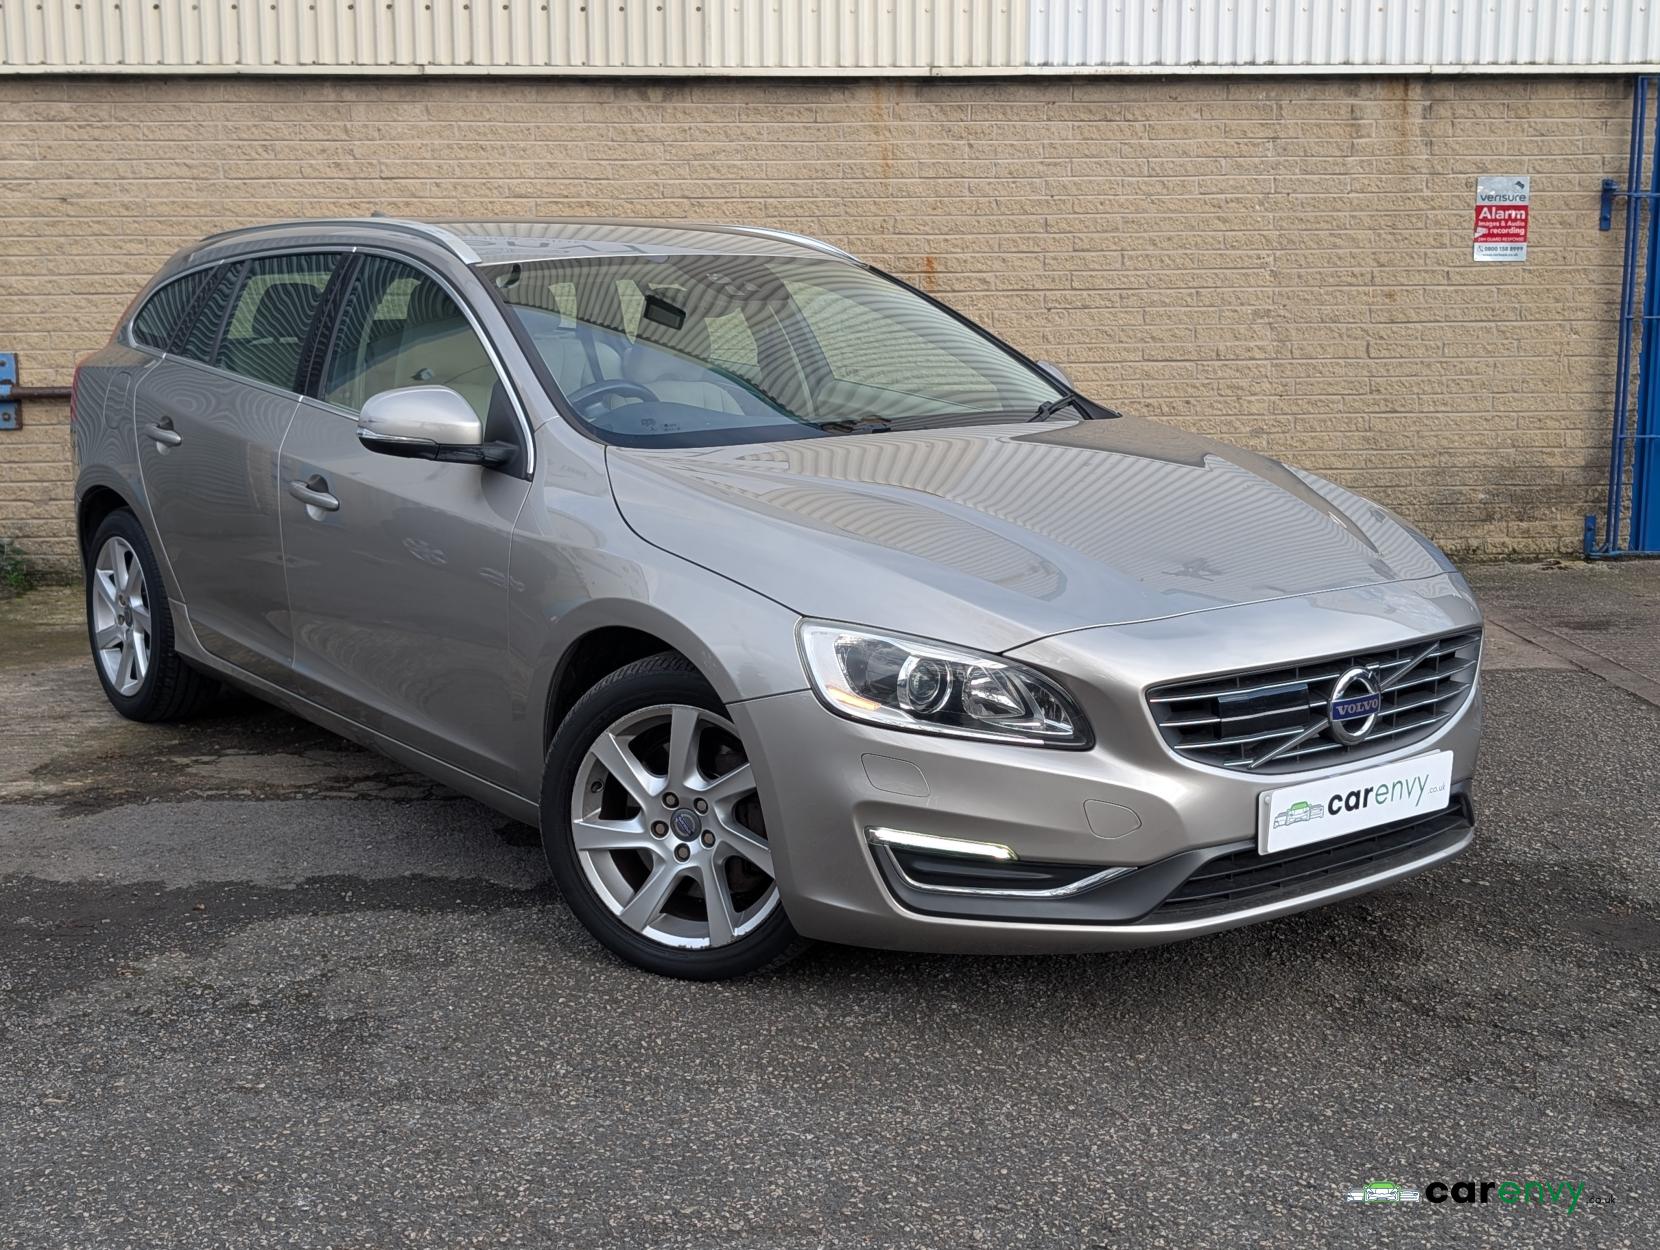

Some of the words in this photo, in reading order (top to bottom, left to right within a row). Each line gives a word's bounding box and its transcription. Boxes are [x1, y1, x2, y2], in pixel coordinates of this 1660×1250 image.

[1480, 194, 1527, 202] verisure
[1479, 207, 1525, 219] Alarm
[1490, 227, 1525, 236] recording
[1336, 699, 1379, 716] VOLVO
